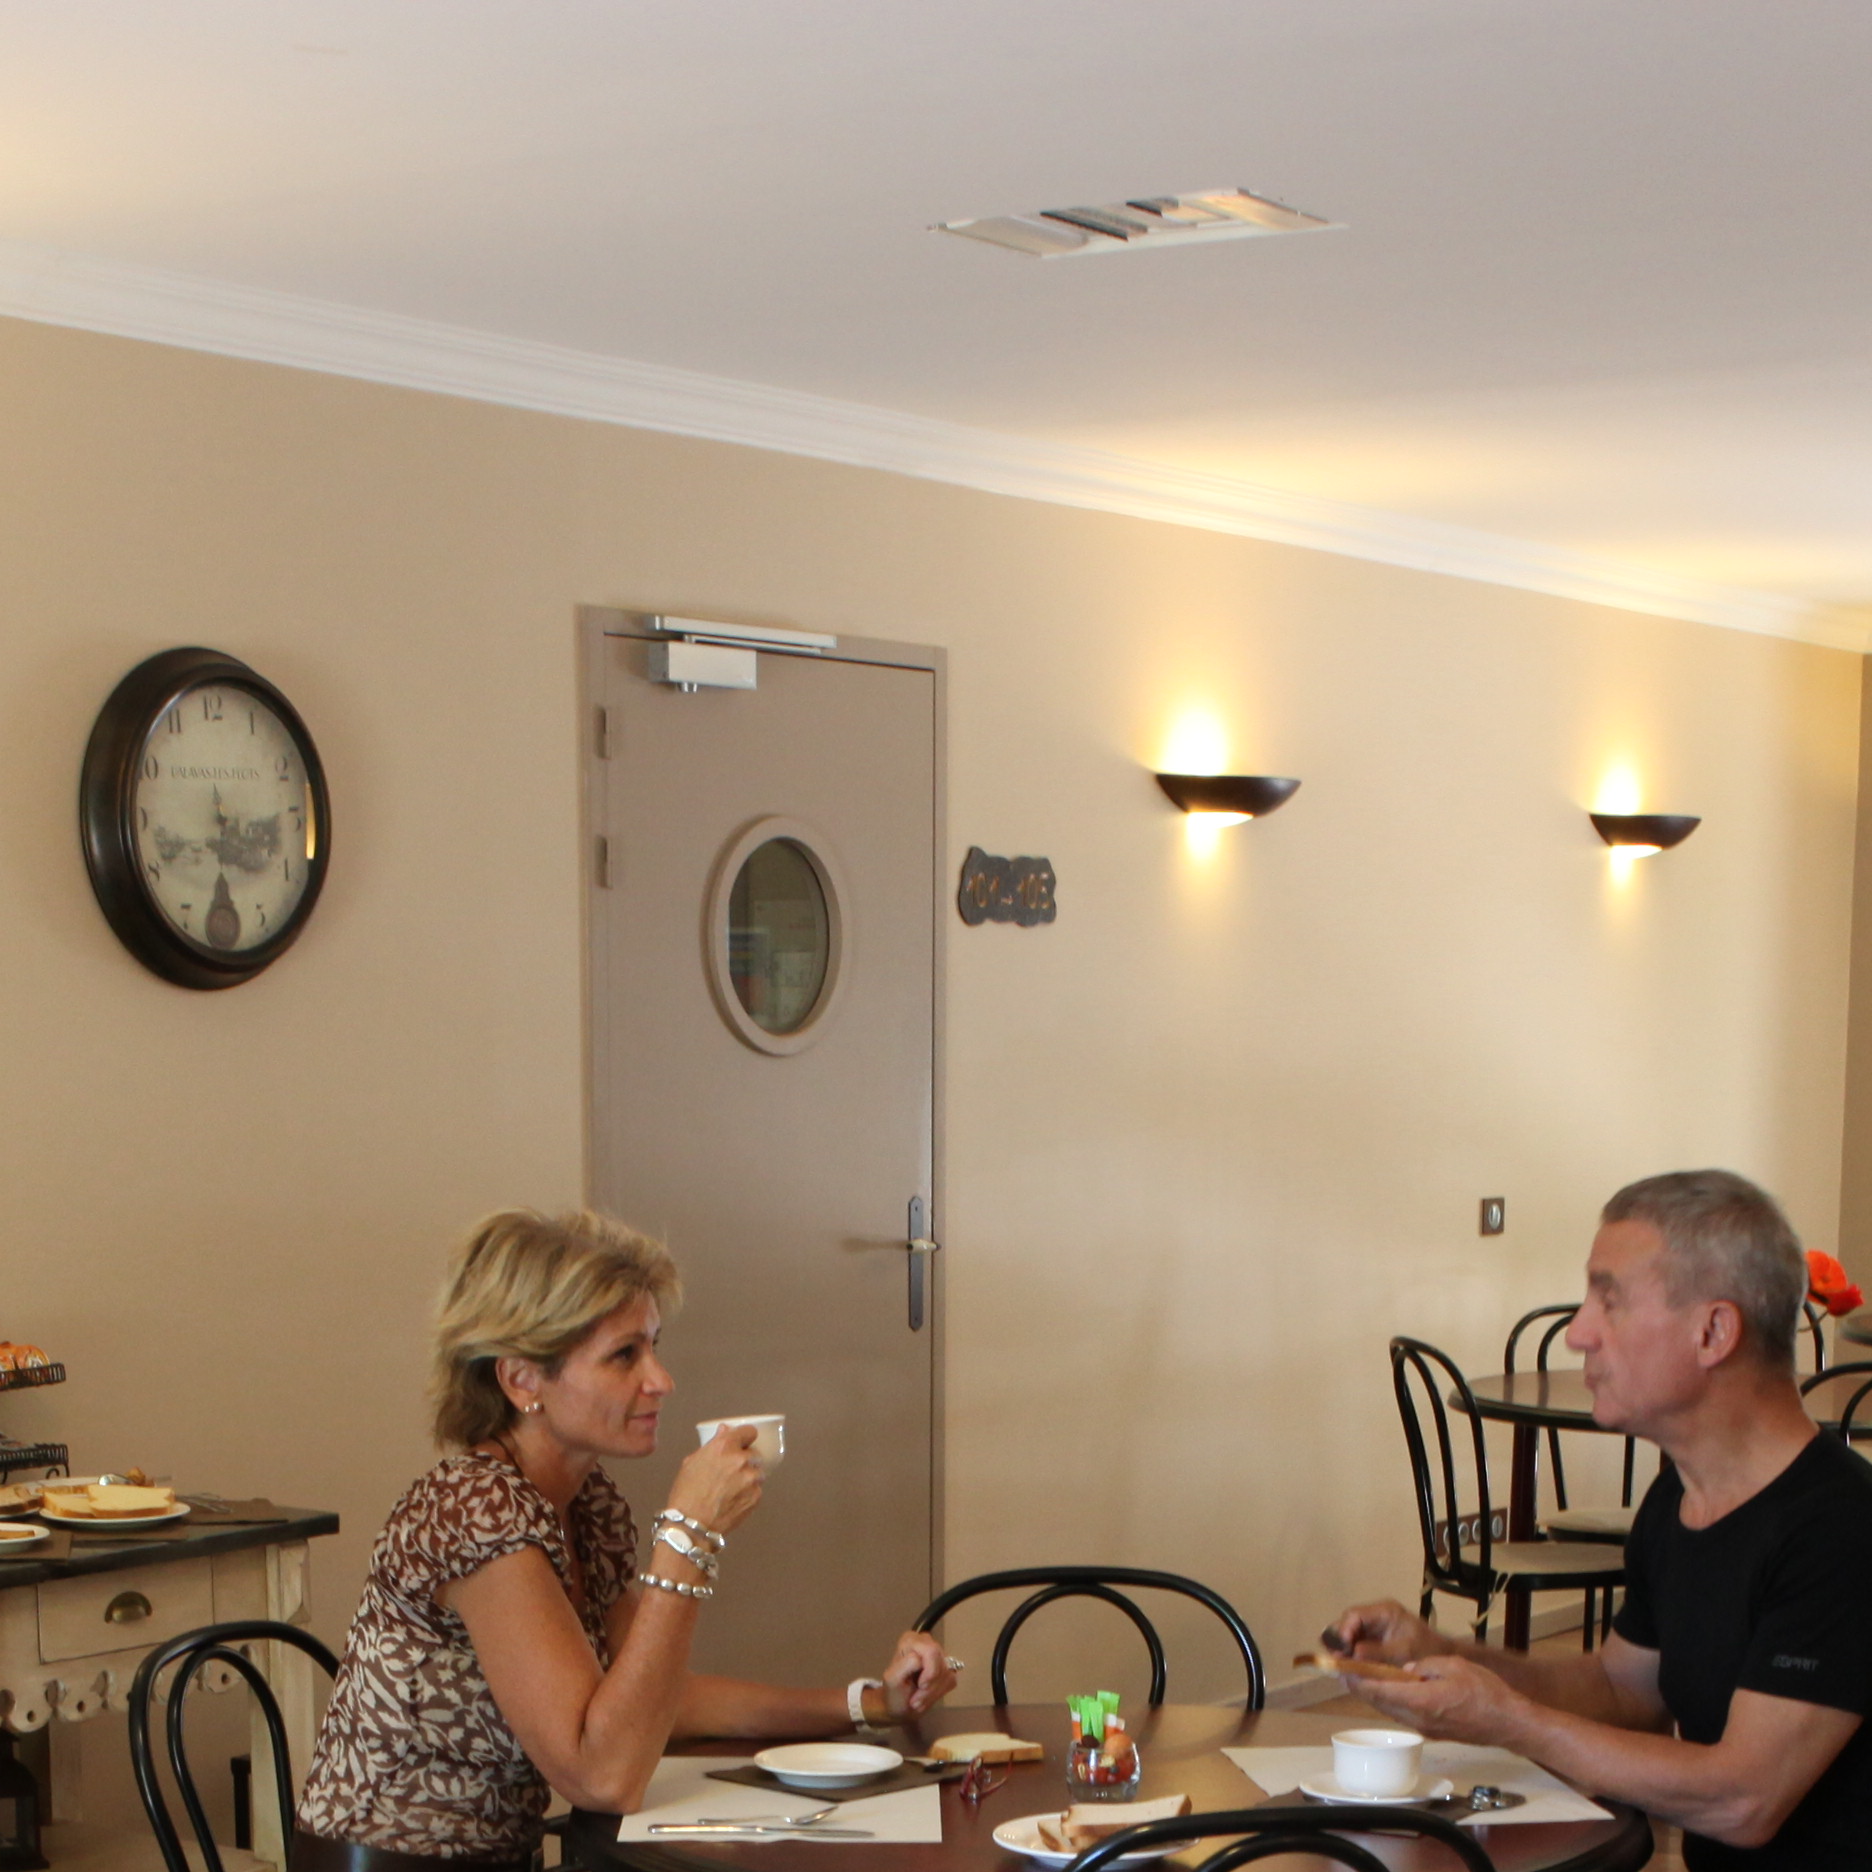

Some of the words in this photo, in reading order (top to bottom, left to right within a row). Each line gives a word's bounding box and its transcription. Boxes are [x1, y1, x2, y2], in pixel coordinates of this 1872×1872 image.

[203, 695, 223, 720] 12
[168, 708, 182, 734] 11
[274, 756, 289, 782] 2
[1770, 1653, 1820, 1672] ESPRIT
